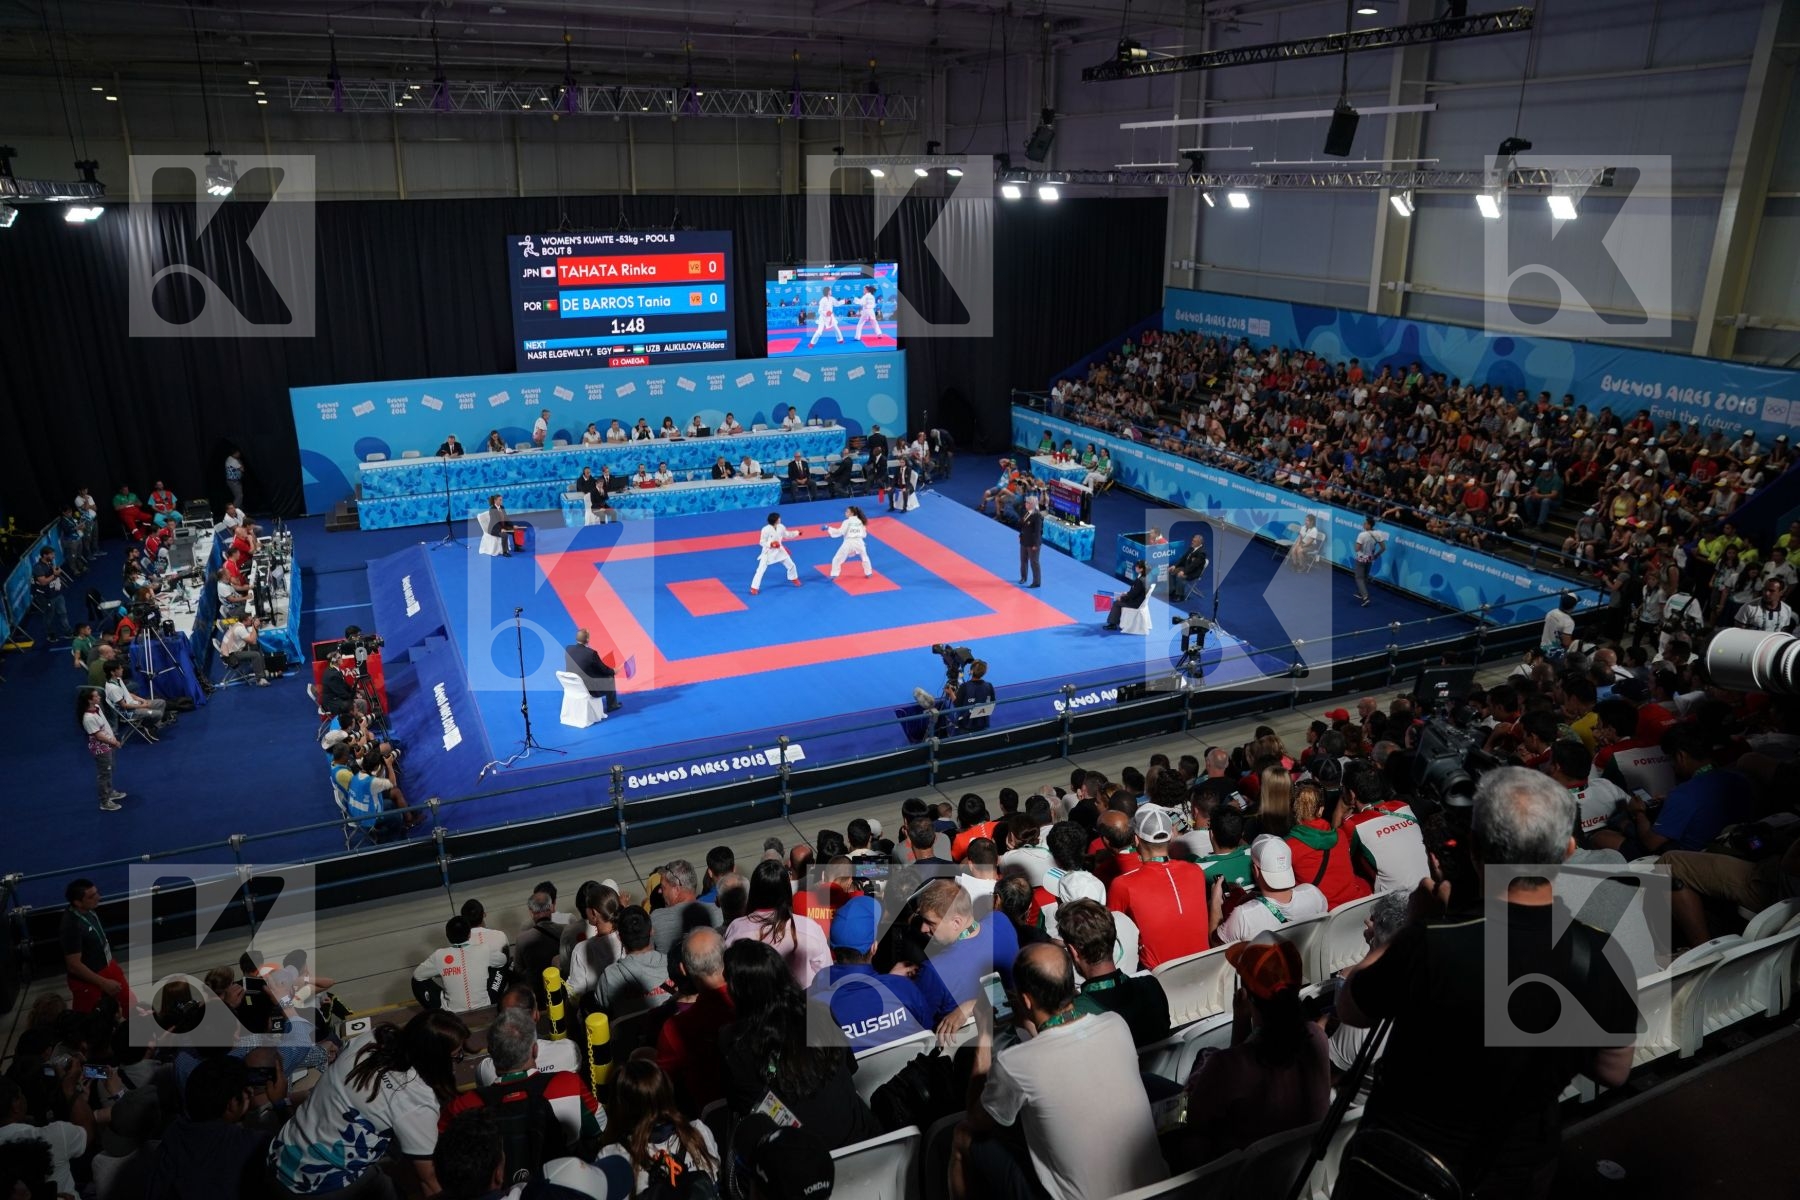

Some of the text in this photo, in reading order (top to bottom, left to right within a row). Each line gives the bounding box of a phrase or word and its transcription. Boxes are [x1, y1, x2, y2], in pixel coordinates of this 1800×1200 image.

[540, 236, 582, 245] WOMEN'S
[583, 235, 614, 244] KUMITE
[645, 234, 668, 243] POOL
[669, 234, 675, 242] B
[541, 247, 572, 256] BOUT 8
[522, 268, 540, 278] JPN
[560, 263, 656, 278] TAHATA Rinka
[523, 301, 542, 311] POR
[562, 295, 670, 311] DE BARROS Tania
[611, 318, 645, 334] 1:48
[1227, 317, 1246, 331] 2018
[526, 341, 547, 350] NEXT
[527, 351, 547, 360] NASR
[549, 349, 585, 359] ELGEWILY
[597, 347, 612, 356] EGY
[645, 344, 660, 353] UZB
[664, 343, 701, 352] ALIKULOVA
[702, 341, 725, 350] Dildora
[1600, 374, 1757, 415] BUENOS AIRES 2018
[1650, 404, 1742, 432] Feel the future
[1121, 545, 1139, 558] COACH
[1152, 549, 1176, 558] COACH
[1100, 688, 1118, 701] AIR
[628, 753, 766, 789] BUENOS AIRES 2018
[1376, 819, 1414, 838] PORTUG
[807, 907, 834, 920] MONTE
[442, 966, 461, 977] JAPAN
[841, 1007, 906, 1039] RUSSIA
